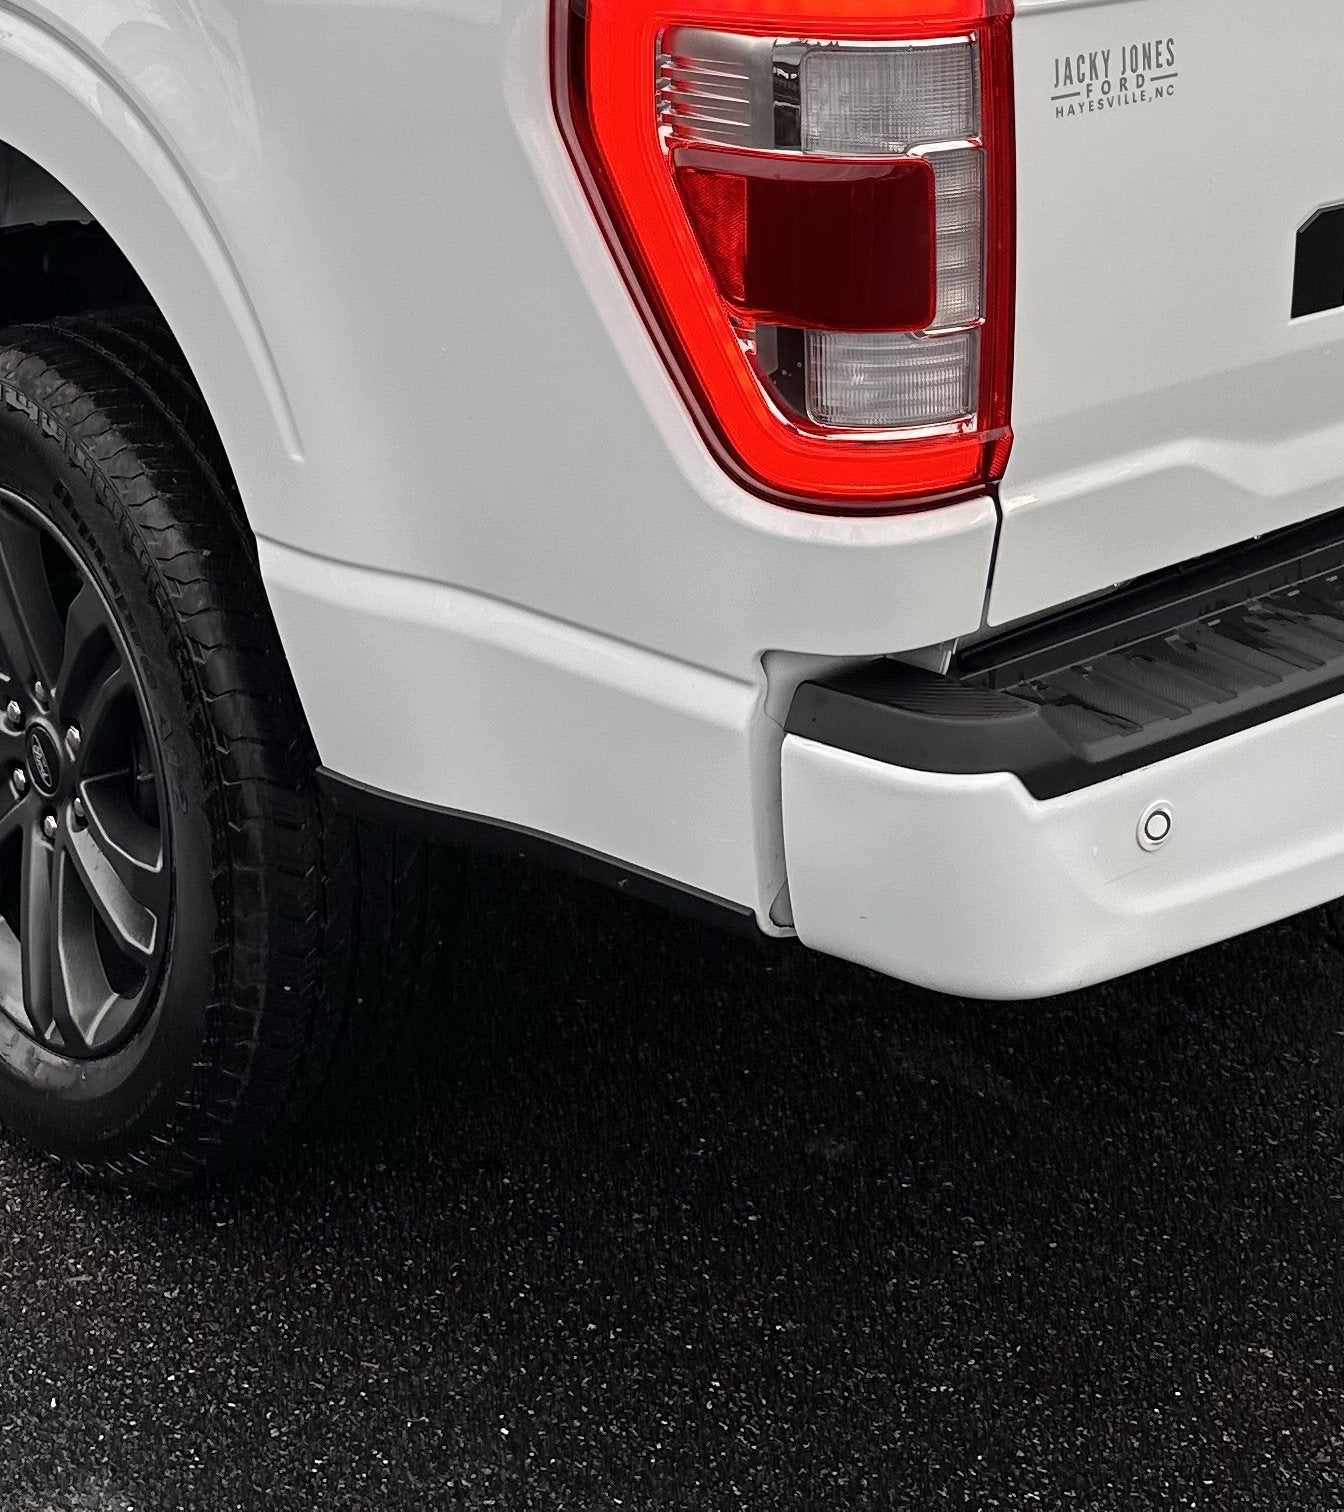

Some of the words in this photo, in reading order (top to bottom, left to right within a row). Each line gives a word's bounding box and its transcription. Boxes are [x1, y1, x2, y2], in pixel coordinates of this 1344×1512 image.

[1054, 48, 1111, 89] JACKY
[1120, 37, 1176, 76] JONES
[1086, 73, 1146, 99] FORD
